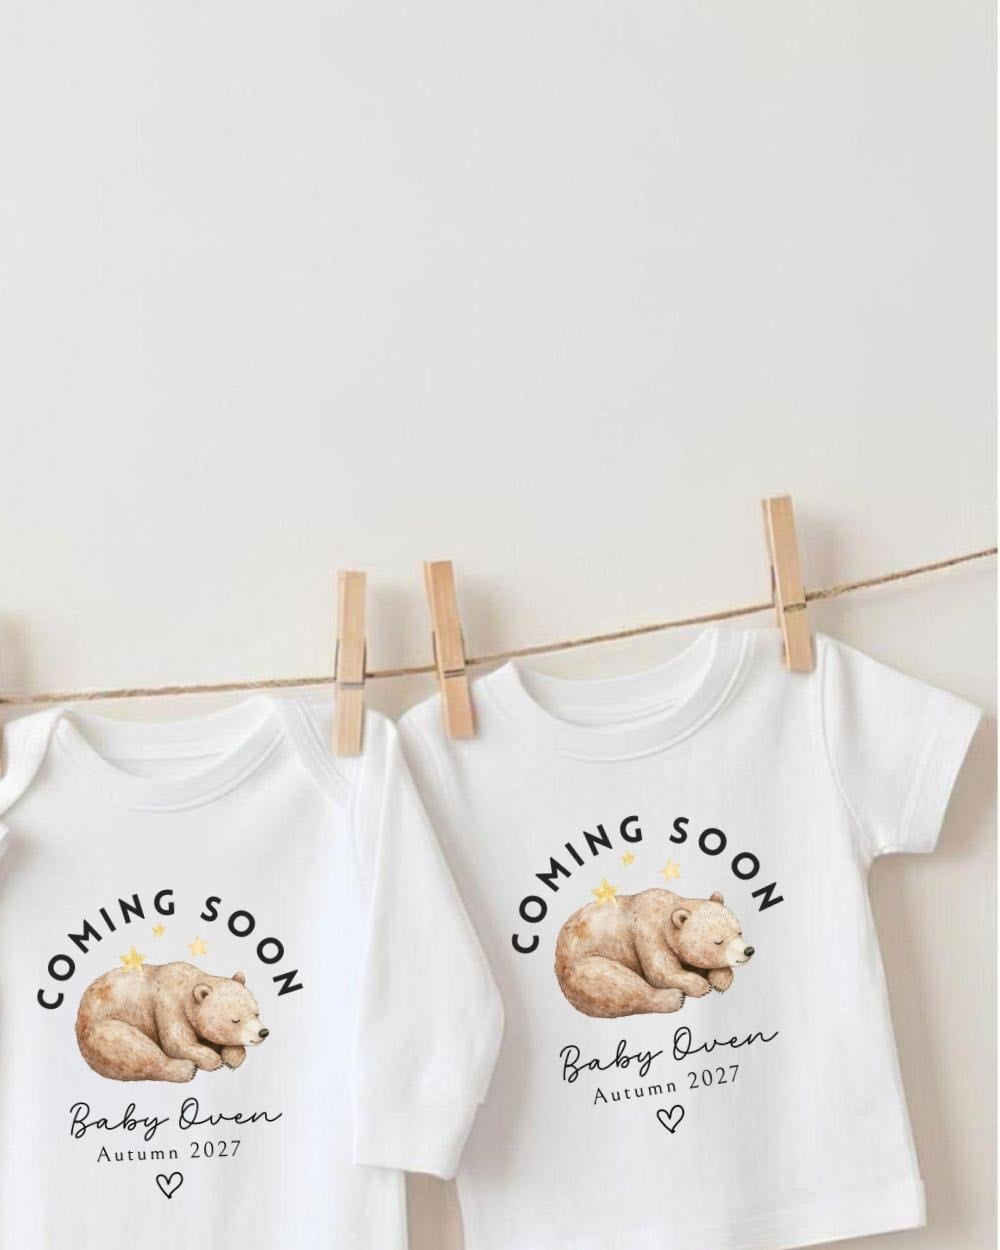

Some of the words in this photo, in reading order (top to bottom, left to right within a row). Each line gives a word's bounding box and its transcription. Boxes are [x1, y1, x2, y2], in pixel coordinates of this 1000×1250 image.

[511, 815, 643, 954] COMING
[670, 816, 785, 913] SOON
[37, 889, 175, 1010] COMING
[200, 896, 304, 997] SOON
[559, 1039, 664, 1084] Baby
[672, 1026, 779, 1061] Oven
[593, 1082, 677, 1105] Autumn
[687, 1064, 740, 1089] 2027
[69, 1102, 169, 1141] Baby
[178, 1097, 283, 1131] Oven
[97, 1146, 178, 1163] Autumn
[190, 1140, 241, 1158] 2027
